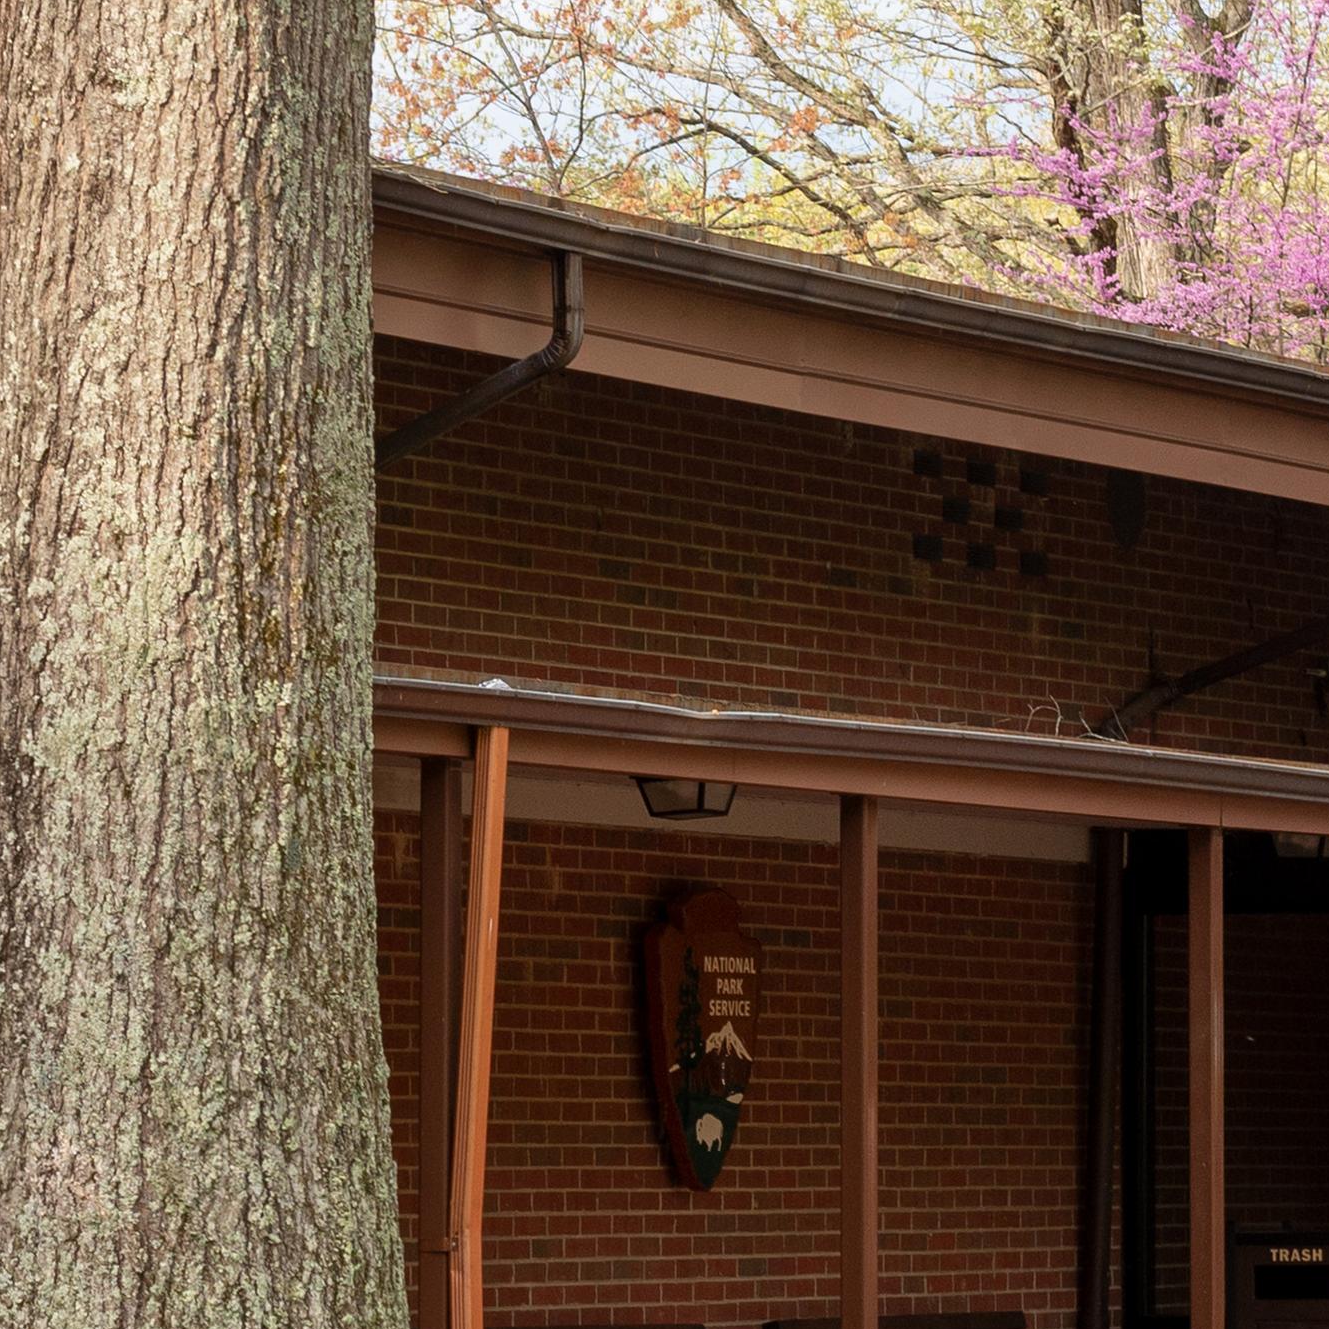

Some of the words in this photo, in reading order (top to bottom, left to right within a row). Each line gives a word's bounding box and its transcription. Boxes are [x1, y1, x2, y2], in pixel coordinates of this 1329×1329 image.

[703, 955, 757, 974] NATIONAL
[716, 978, 744, 995] PARK
[708, 999, 751, 1017] SERVICE
[1270, 1248, 1324, 1262] TRASH
